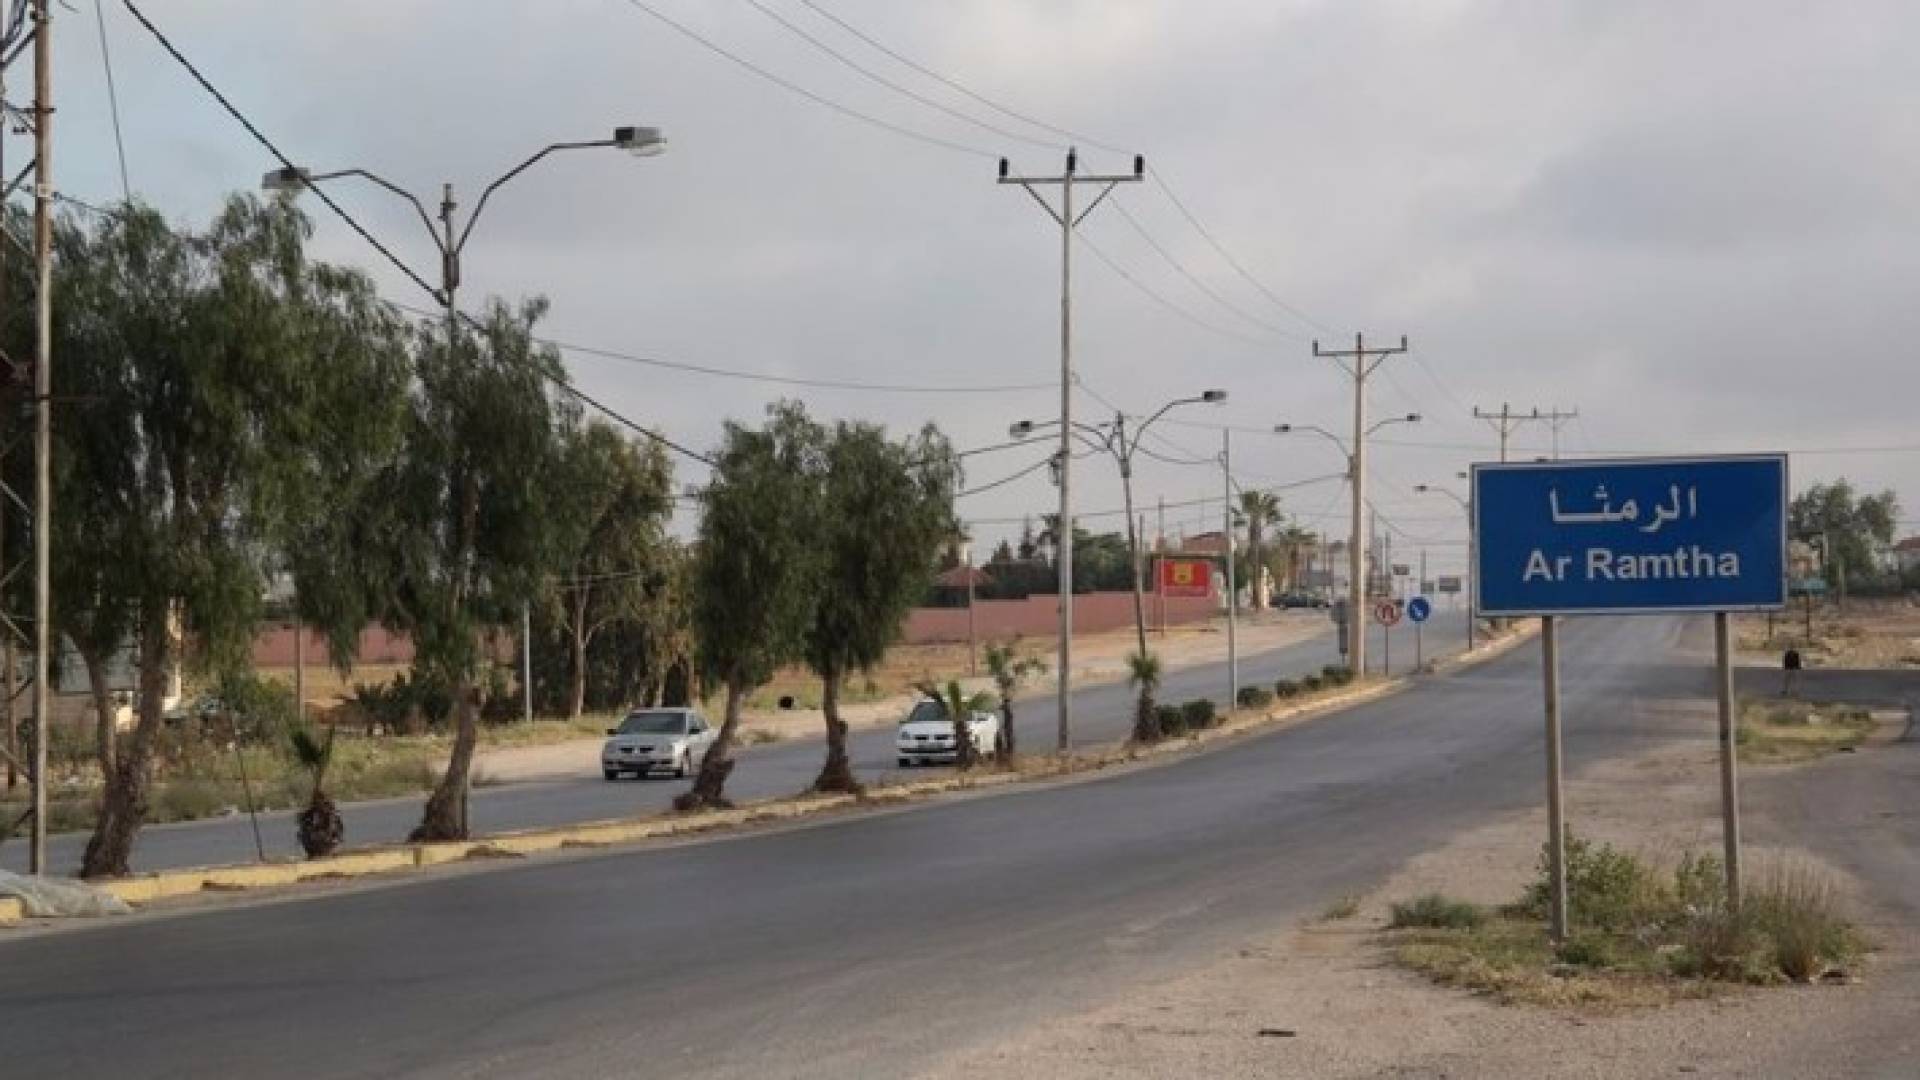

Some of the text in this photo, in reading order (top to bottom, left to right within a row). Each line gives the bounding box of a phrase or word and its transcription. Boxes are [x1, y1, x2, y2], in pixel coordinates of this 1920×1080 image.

[1550, 484, 1697, 532] الرمثا
[1522, 546, 1739, 582] Ar Ramtha
